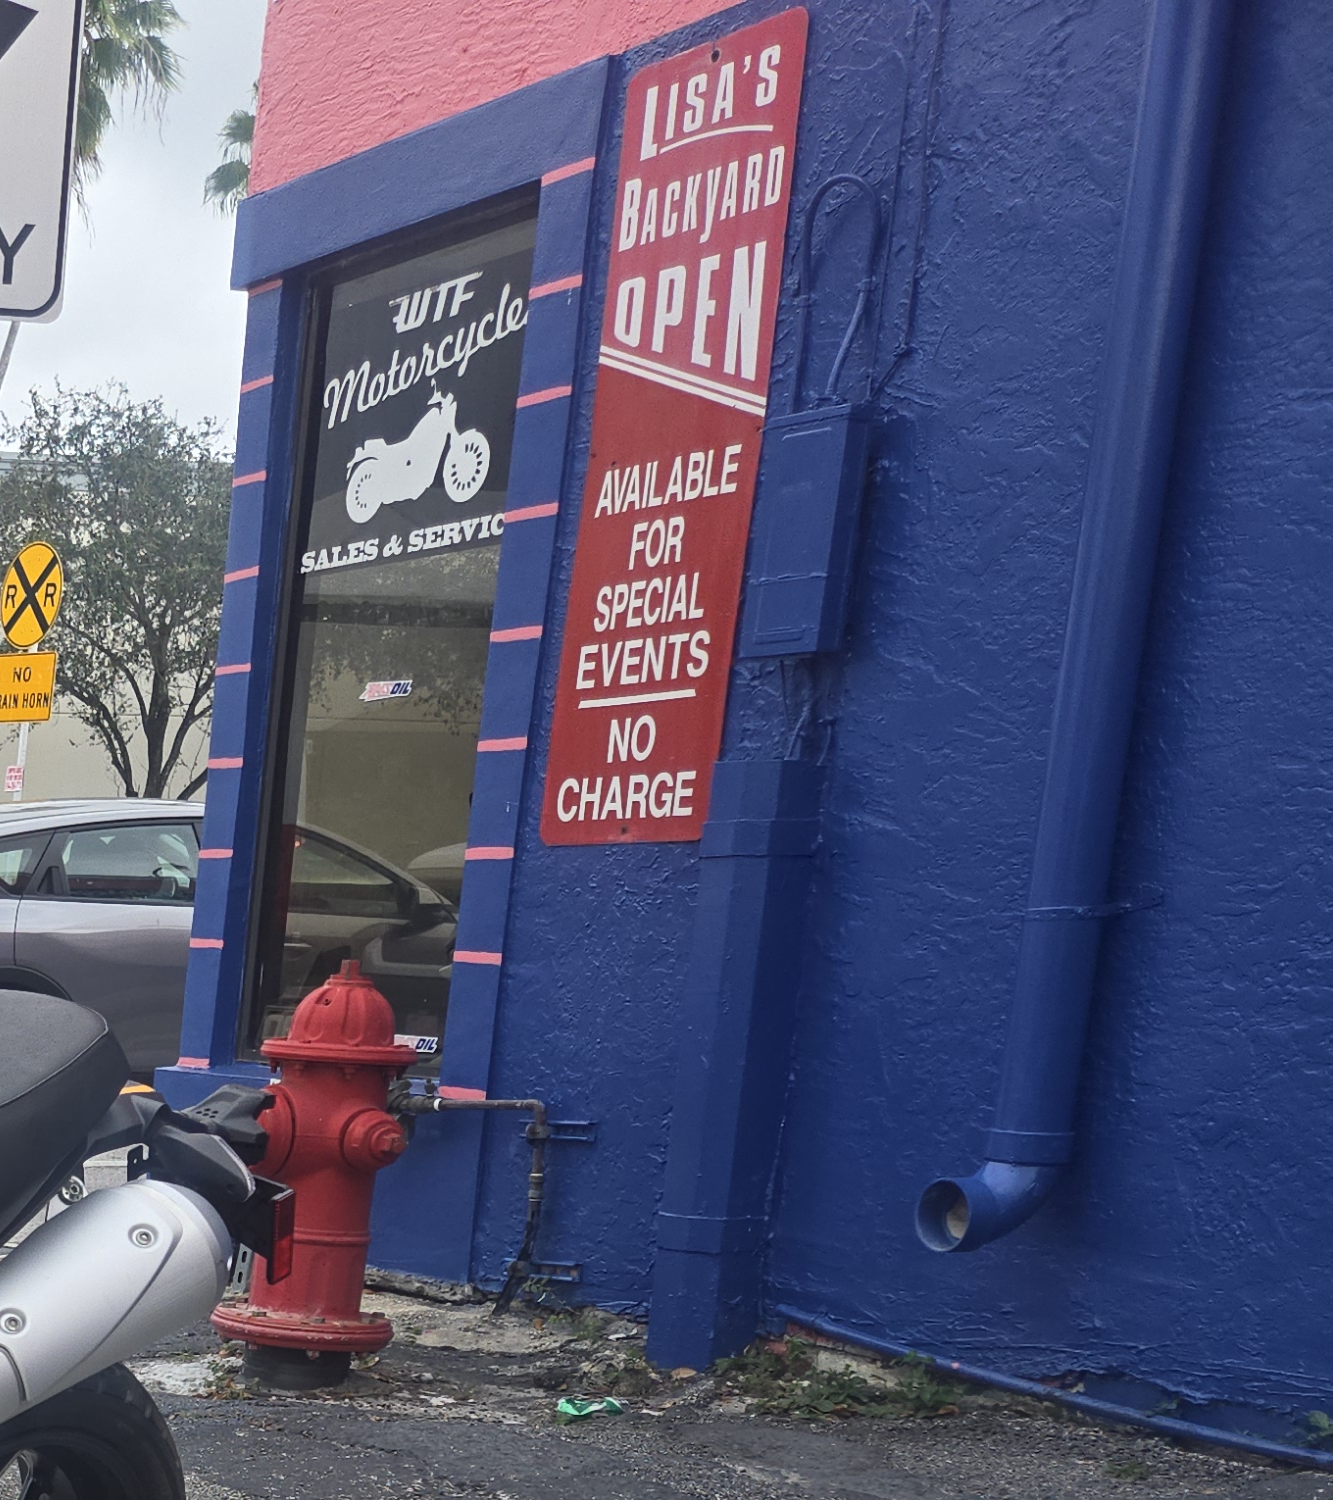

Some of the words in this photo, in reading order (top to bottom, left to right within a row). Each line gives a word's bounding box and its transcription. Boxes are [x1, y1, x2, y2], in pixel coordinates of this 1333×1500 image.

[640, 44, 781, 161] LISA'S
[618, 145, 785, 251] BACKYARD
[389, 271, 483, 333] WTF
[613, 240, 767, 381] OPEN
[324, 283, 530, 429] Motorcycle
[594, 444, 742, 518] AVAILABLE
[301, 539, 378, 574] SALES
[383, 536, 404, 559] &
[628, 516, 685, 570] FOR
[5, 584, 18, 608] R
[43, 583, 57, 607] R
[593, 572, 704, 632] SPECIAL
[12, 667, 31, 683] NO
[576, 630, 710, 689] EVENTS
[22, 692, 49, 709] HORN
[607, 714, 657, 763] NO
[557, 771, 697, 822] CHARGE
